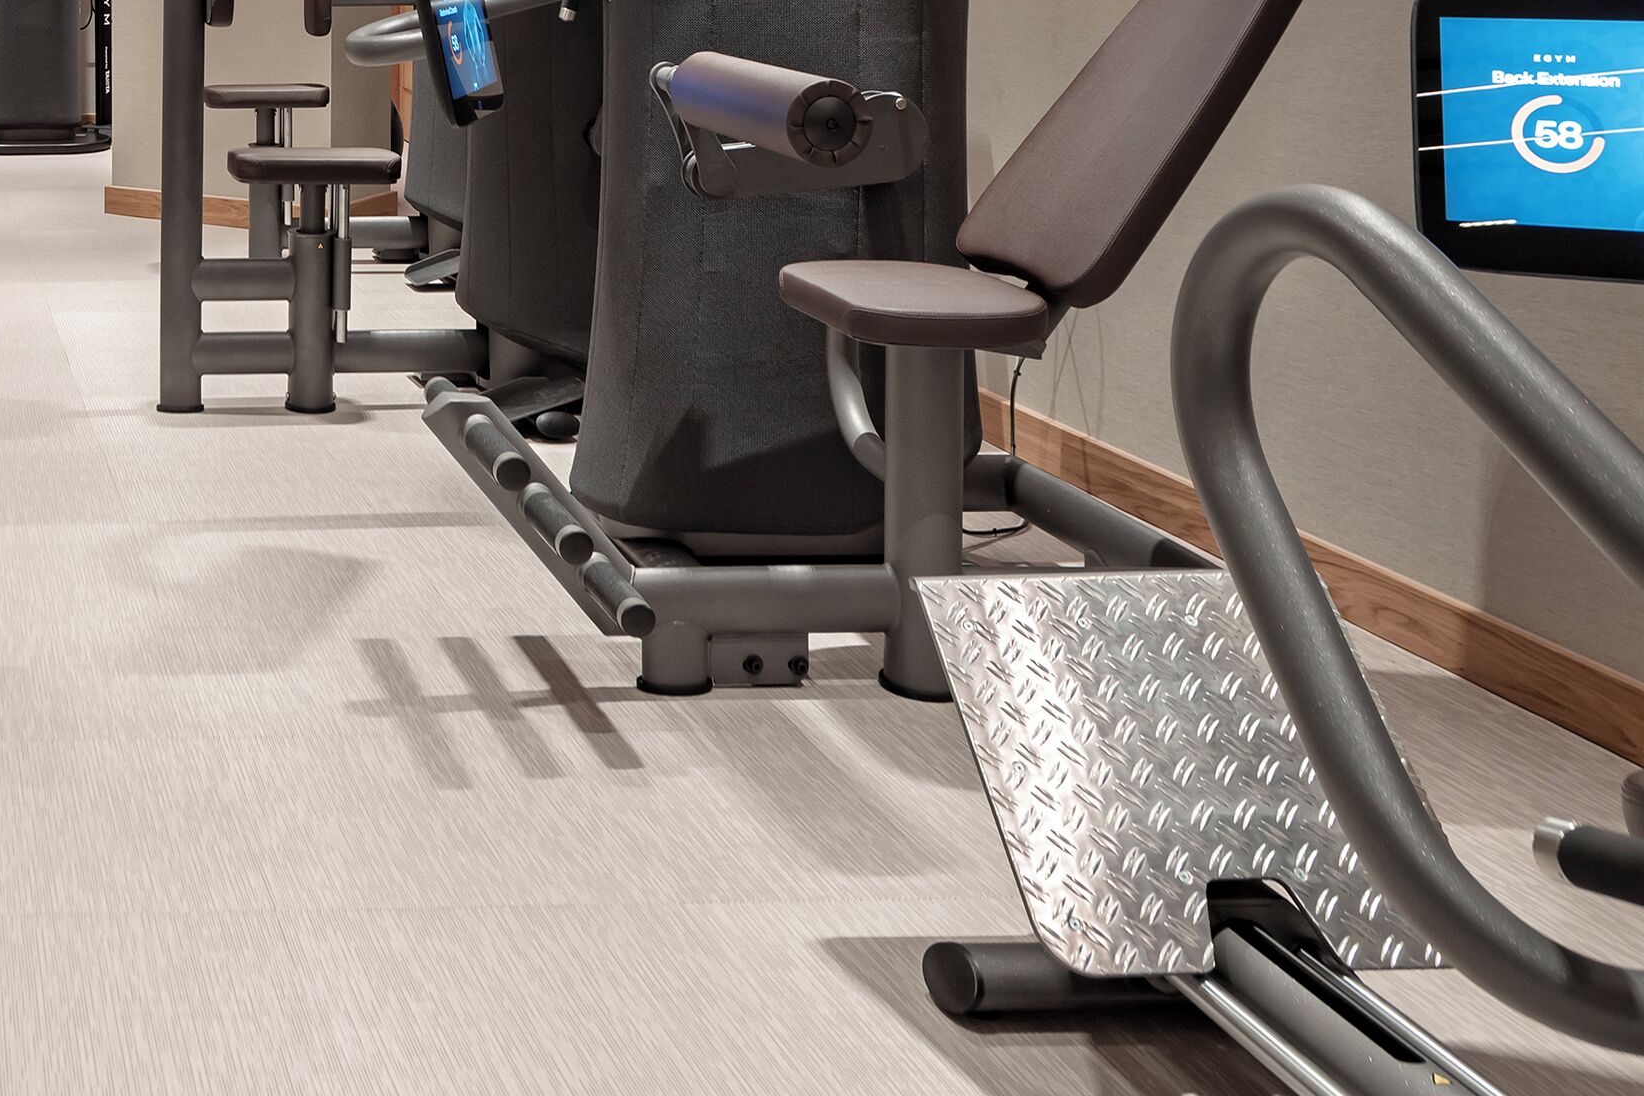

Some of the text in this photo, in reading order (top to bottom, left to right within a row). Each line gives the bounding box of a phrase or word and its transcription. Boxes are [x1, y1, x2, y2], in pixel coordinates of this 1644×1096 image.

[1532, 53, 1576, 64] EGYM
[1491, 69, 1534, 86] Back
[1534, 119, 1584, 150] 58
